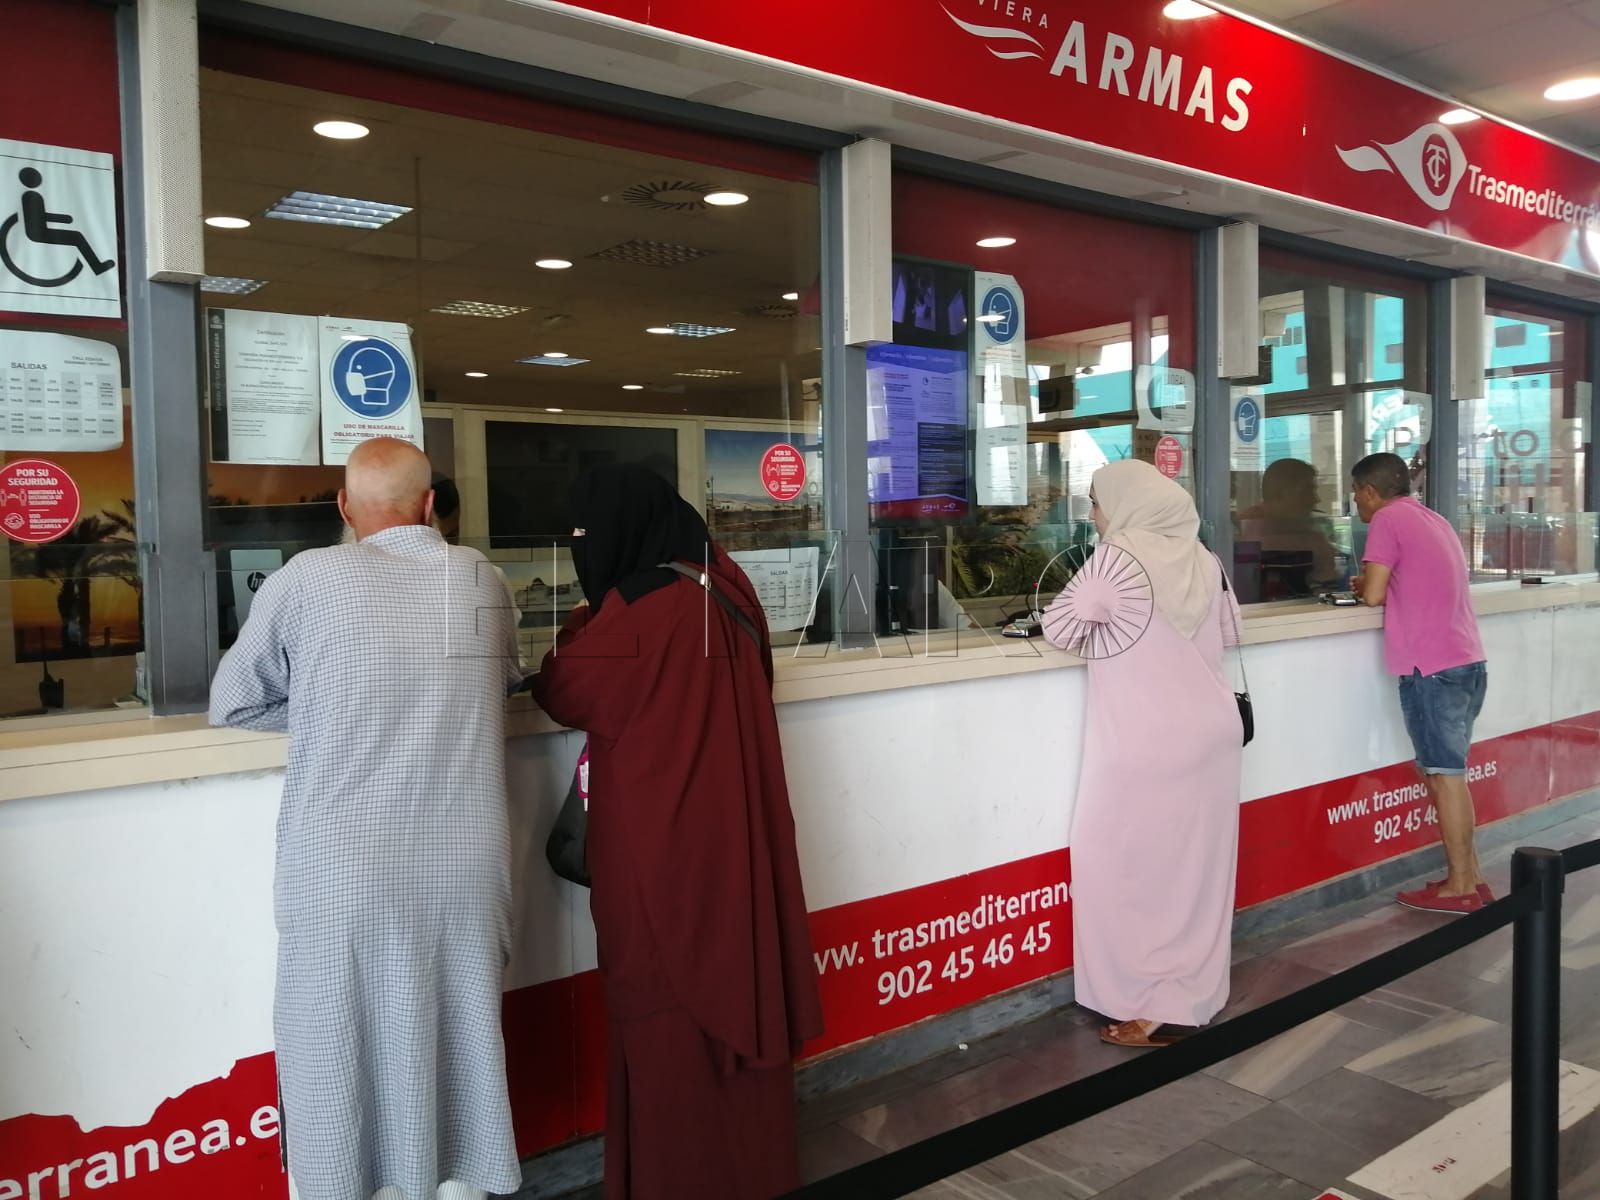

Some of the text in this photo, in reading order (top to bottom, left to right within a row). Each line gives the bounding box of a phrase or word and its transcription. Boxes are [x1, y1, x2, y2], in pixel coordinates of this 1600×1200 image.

[1050, 20, 1253, 132] ARMAS
[1468, 164, 1600, 230] Trasmediterrá
[10, 361, 48, 370] SALIDAS
[367, 423, 405, 431] MASCARILLA
[8, 478, 58, 486] SEGURIDAD
[16, 468, 49, 477] POR SU
[1327, 797, 1370, 825] www.
[1374, 815, 1401, 844] 902
[1404, 808, 1421, 833] 45
[871, 881, 1072, 960] trasmediterran
[877, 921, 1051, 1006] 902 45 46 45
